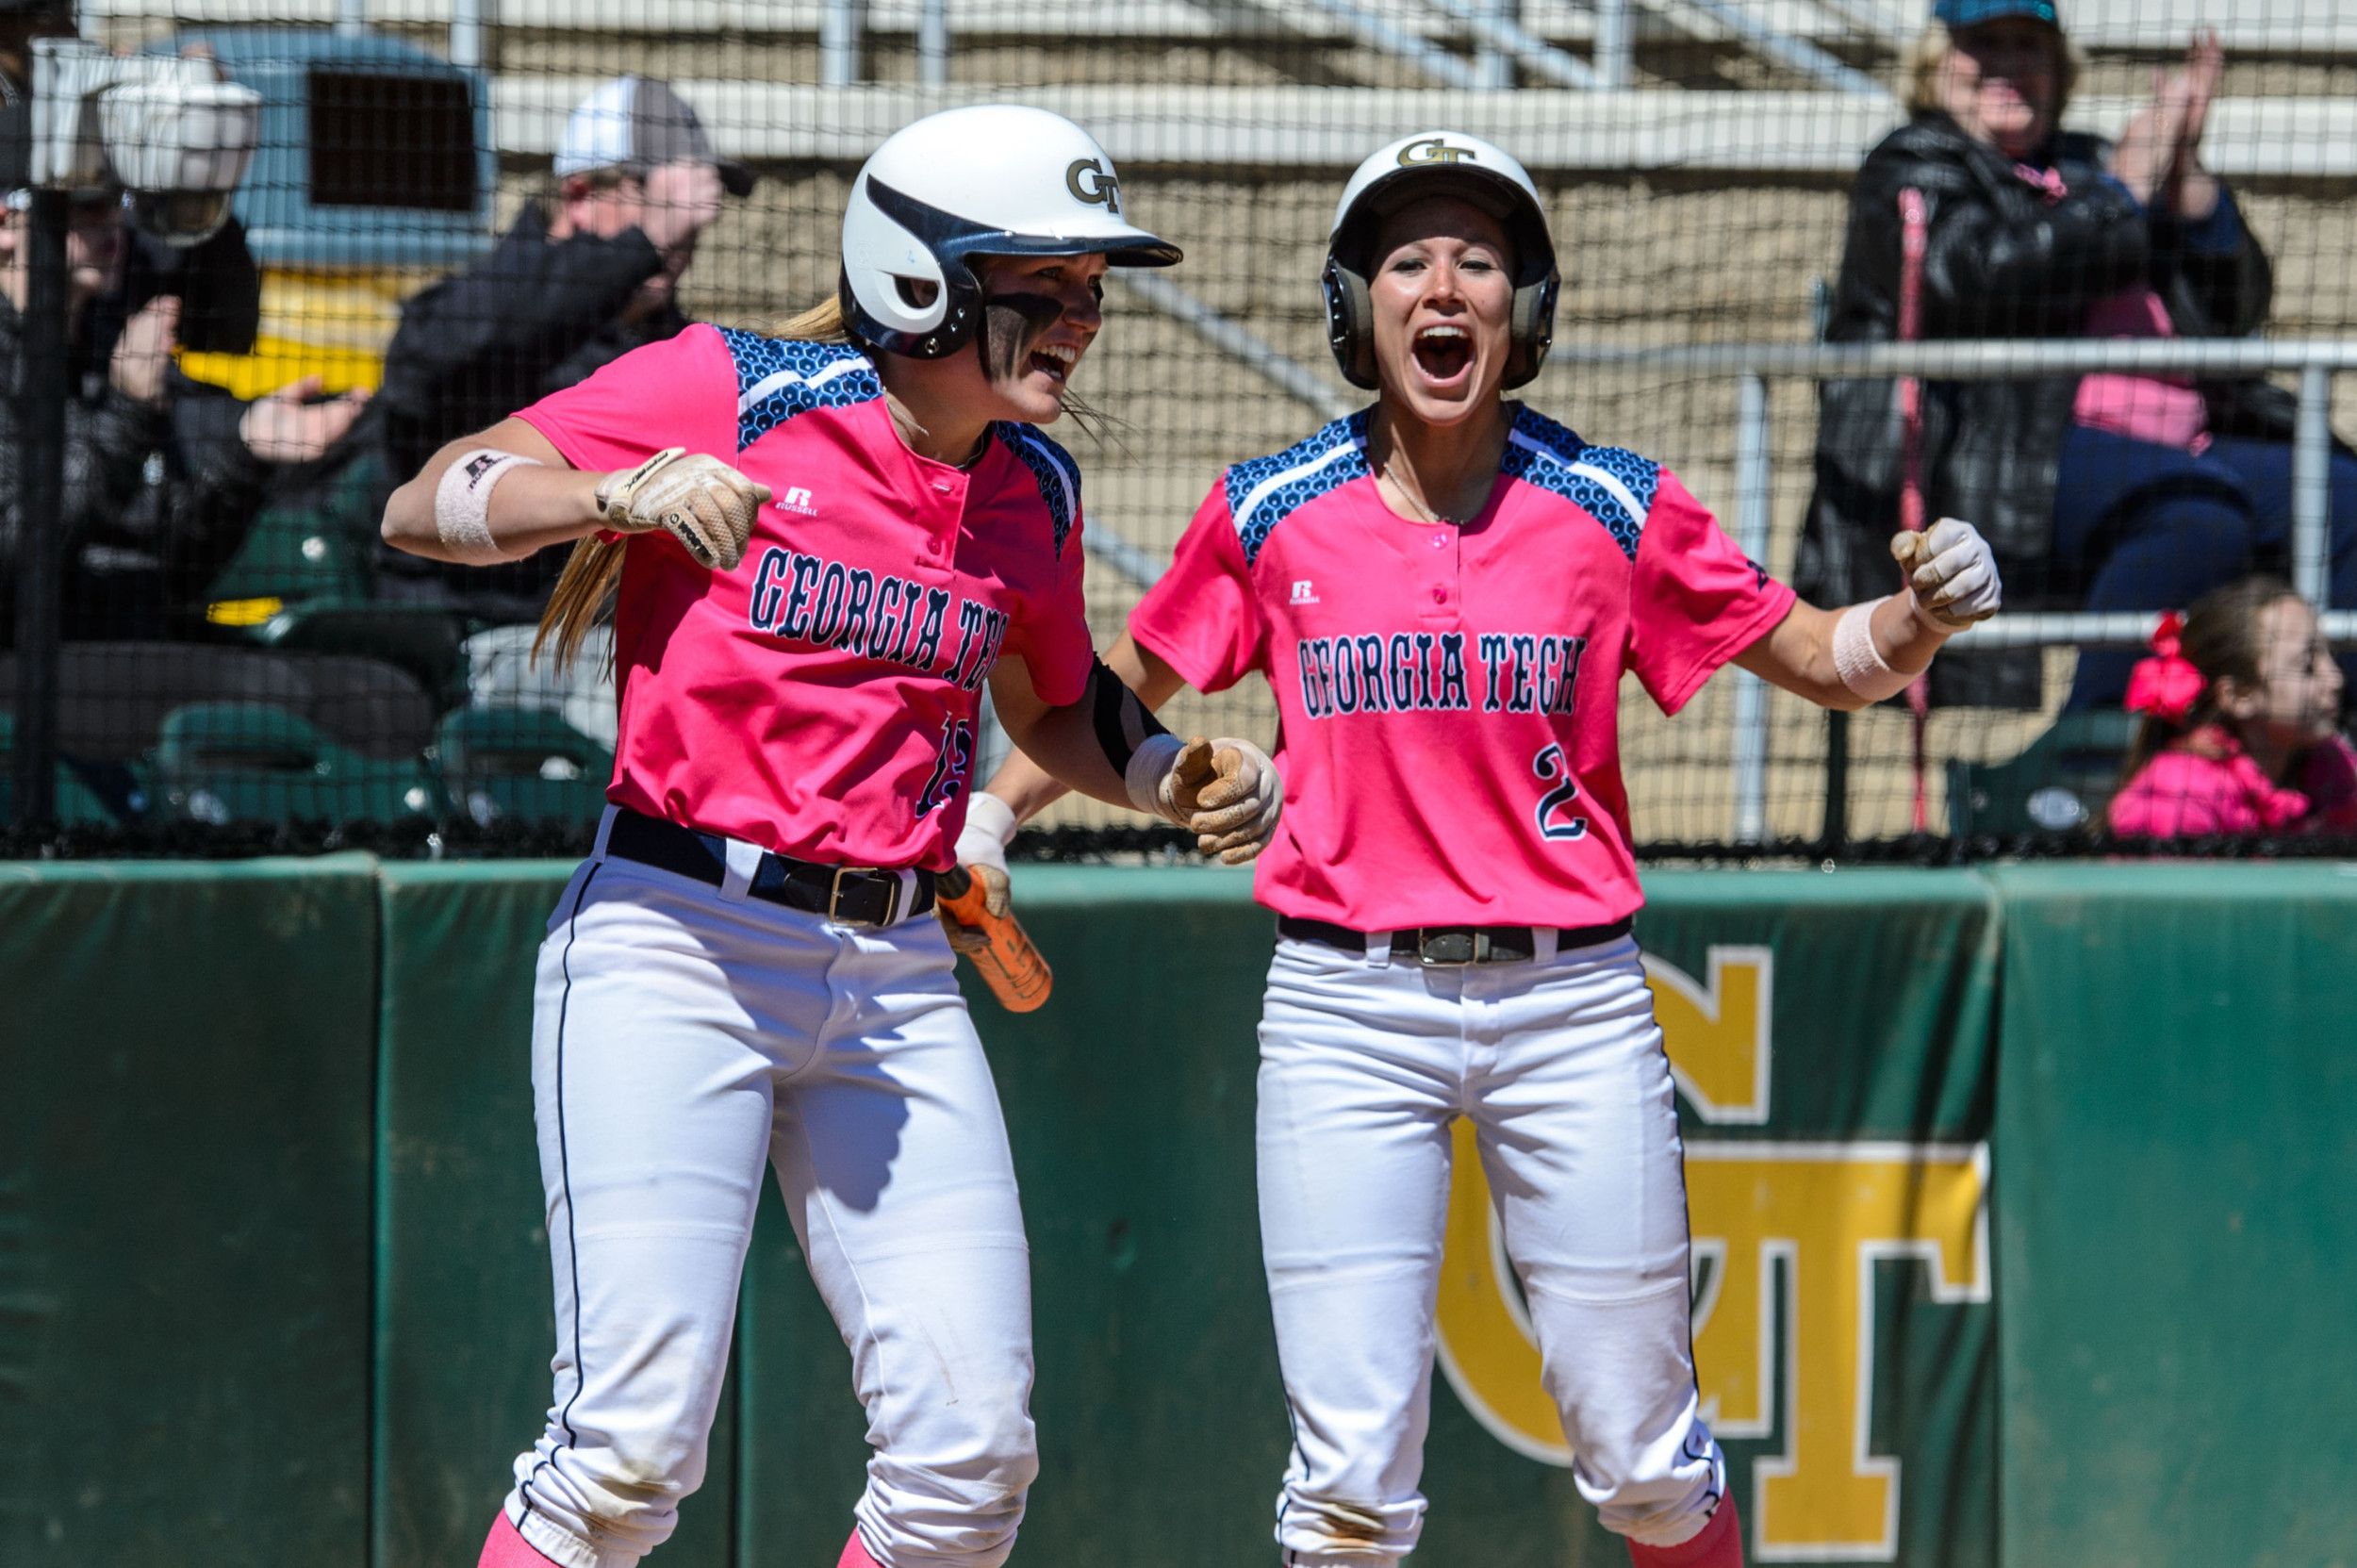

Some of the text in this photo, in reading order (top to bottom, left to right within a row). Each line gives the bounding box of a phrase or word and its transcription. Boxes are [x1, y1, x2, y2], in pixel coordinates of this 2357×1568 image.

[1065, 157, 1119, 214] GT
[1396, 138, 1475, 167] GT
[775, 502, 817, 517] RUSSELL
[750, 546, 949, 672] GEORGIA
[1297, 633, 1587, 719] GEORGIA TECH
[1532, 741, 1588, 841] 2
